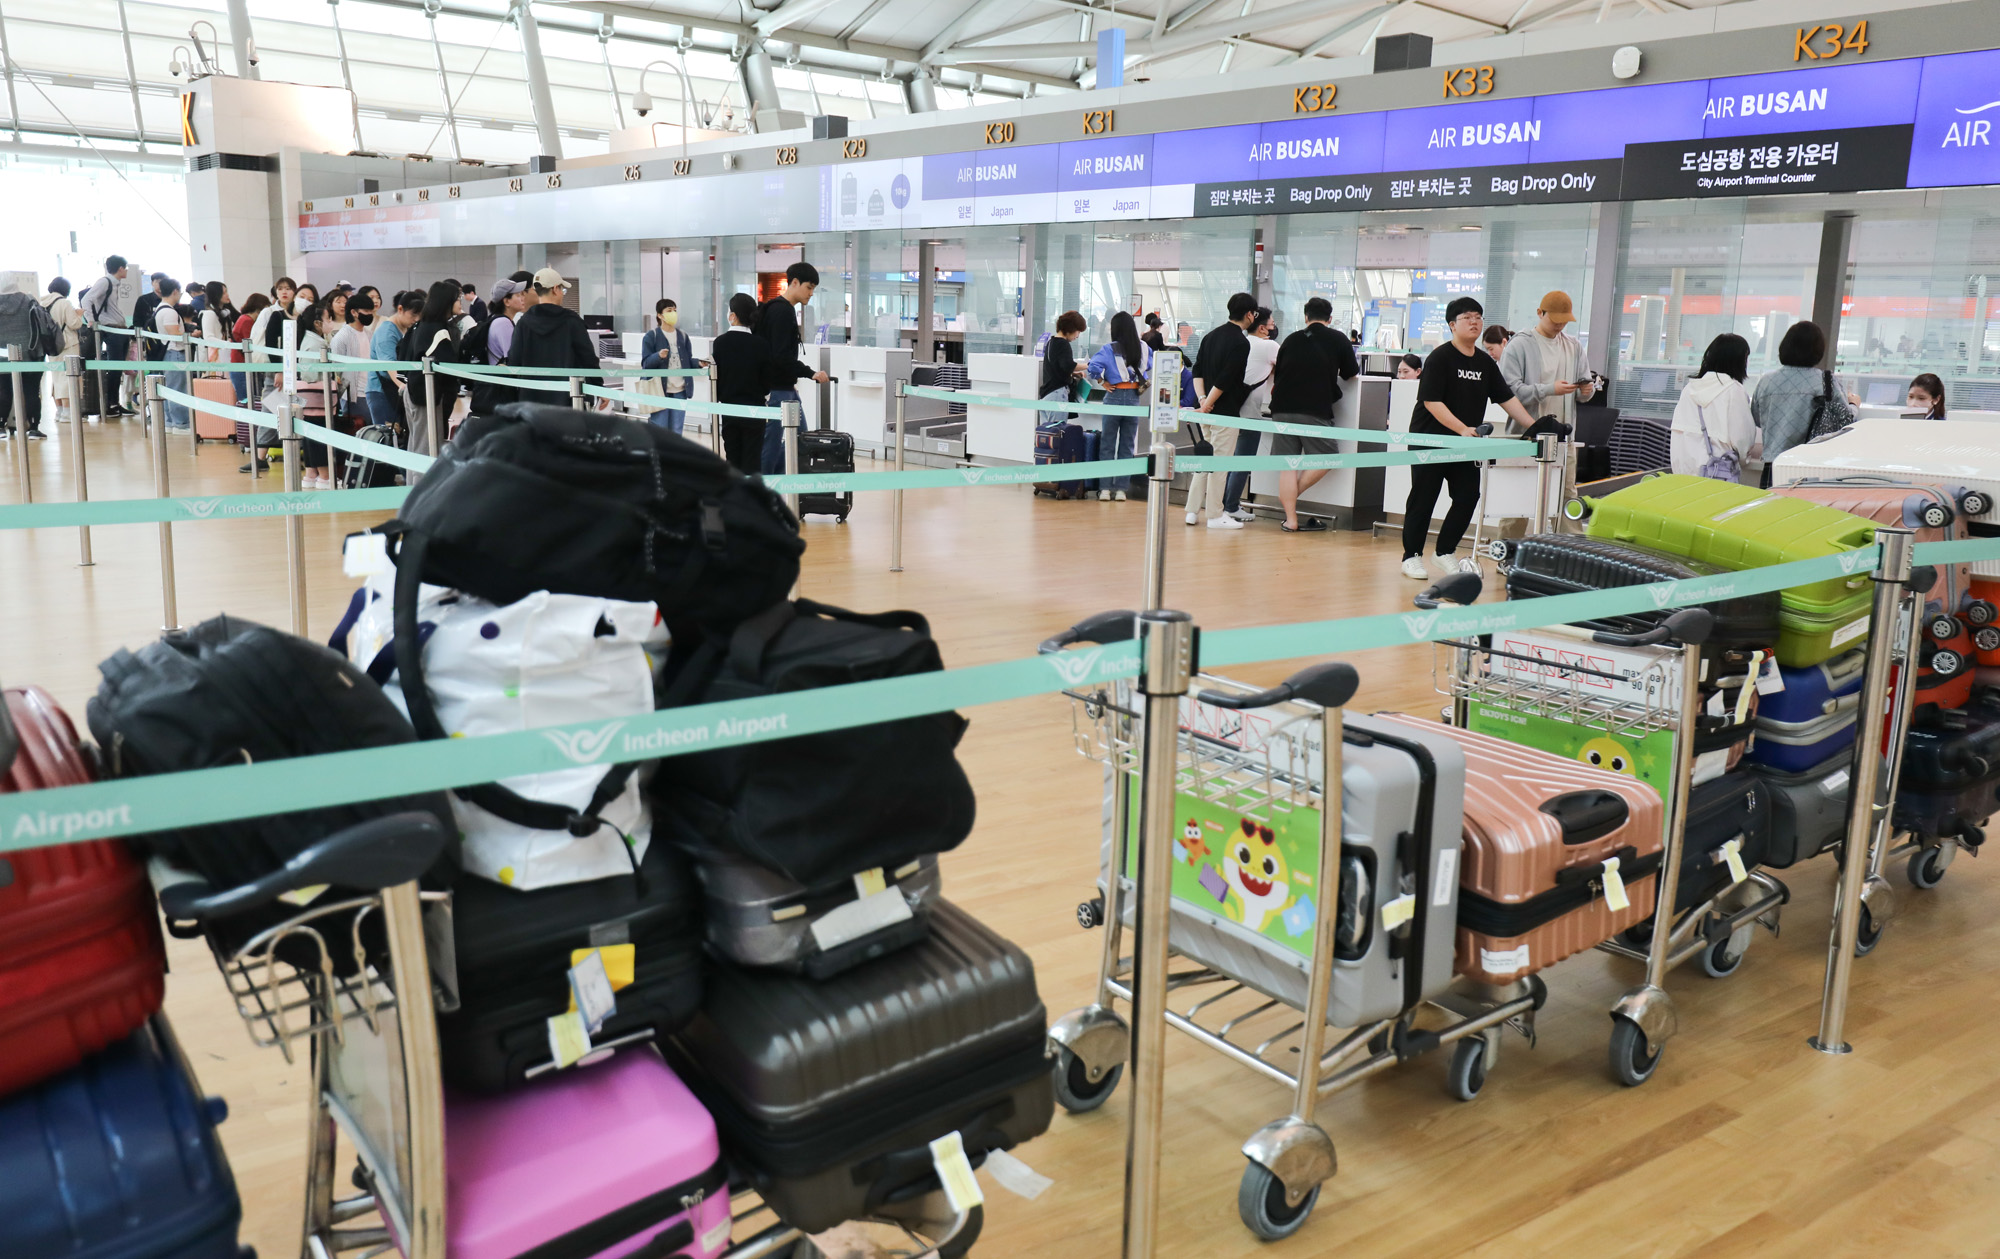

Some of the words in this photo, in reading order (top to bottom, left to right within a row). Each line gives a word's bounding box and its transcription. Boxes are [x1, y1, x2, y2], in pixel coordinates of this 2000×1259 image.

[1793, 20, 1868, 61] K34
[1443, 65, 1495, 98] K33
[1293, 83, 1337, 113] K32
[1703, 96, 1735, 119] AIR
[1740, 88, 1827, 116] BUSAN
[180, 92, 200, 146] K
[1083, 109, 1114, 134] K31
[985, 121, 1015, 144] K30
[1428, 127, 1457, 149] AIR
[1462, 120, 1541, 146] BUSAN
[1941, 120, 1990, 148] AIR
[775, 147, 797, 166] K28
[843, 139, 866, 158] K29
[1249, 143, 1272, 161] AIR
[1276, 137, 1339, 160] BUSAN
[1680, 148, 1745, 172] 도심공항
[1749, 146, 1782, 169] 전용
[1786, 141, 1839, 166] 카운터
[624, 165, 641, 181] K26
[673, 159, 691, 175] K27
[957, 168, 972, 182] AIR
[975, 164, 1017, 182] BUSAN
[1074, 159, 1092, 175] AIR
[1095, 154, 1144, 174] BUSAN
[509, 178, 522, 192] K24
[547, 174, 561, 188] K25
[1390, 179, 1415, 198] 짐만
[1418, 177, 1455, 197] 부치는
[1458, 177, 1473, 195] 곳
[1491, 177, 1519, 195] Bag
[1522, 175, 1557, 193] Drop
[1561, 172, 1596, 191] Only
[1697, 177, 1713, 188] City
[1714, 176, 1742, 188] Airport
[1744, 174, 1779, 186] Terminal
[1781, 172, 1816, 184] Counter
[449, 185, 460, 198] K23
[1210, 190, 1230, 206] 짐만
[1232, 188, 1262, 205] 부치는
[1264, 187, 1275, 204] 곳
[1290, 188, 1312, 204] Bag
[1314, 187, 1342, 202] Drop
[1345, 185, 1372, 201] Only
[958, 205, 972, 219] 일본
[991, 206, 1014, 217] Japan
[1074, 199, 1090, 214] 일본
[1113, 199, 1140, 213] Japan
[1425, 438, 1444, 446] Airport
[1180, 462, 1202, 471] Airport
[1324, 459, 1343, 468] Airport
[1450, 453, 1466, 461] Airport
[781, 482, 815, 491] Incheon
[817, 480, 846, 491] Airport
[984, 472, 1012, 482] Incheon
[1014, 471, 1039, 482] Airport
[224, 502, 274, 514] Incheon
[277, 500, 322, 515] Airport
[1675, 589, 1706, 601] Incheon
[1708, 584, 1735, 598] Airport
[1437, 619, 1478, 633] Incheon
[1480, 614, 1516, 630] Airport
[1101, 655, 1141, 674] Inche
[623, 726, 709, 752] Incheon
[715, 712, 788, 739] Airport
[12, 804, 133, 839] Airport
